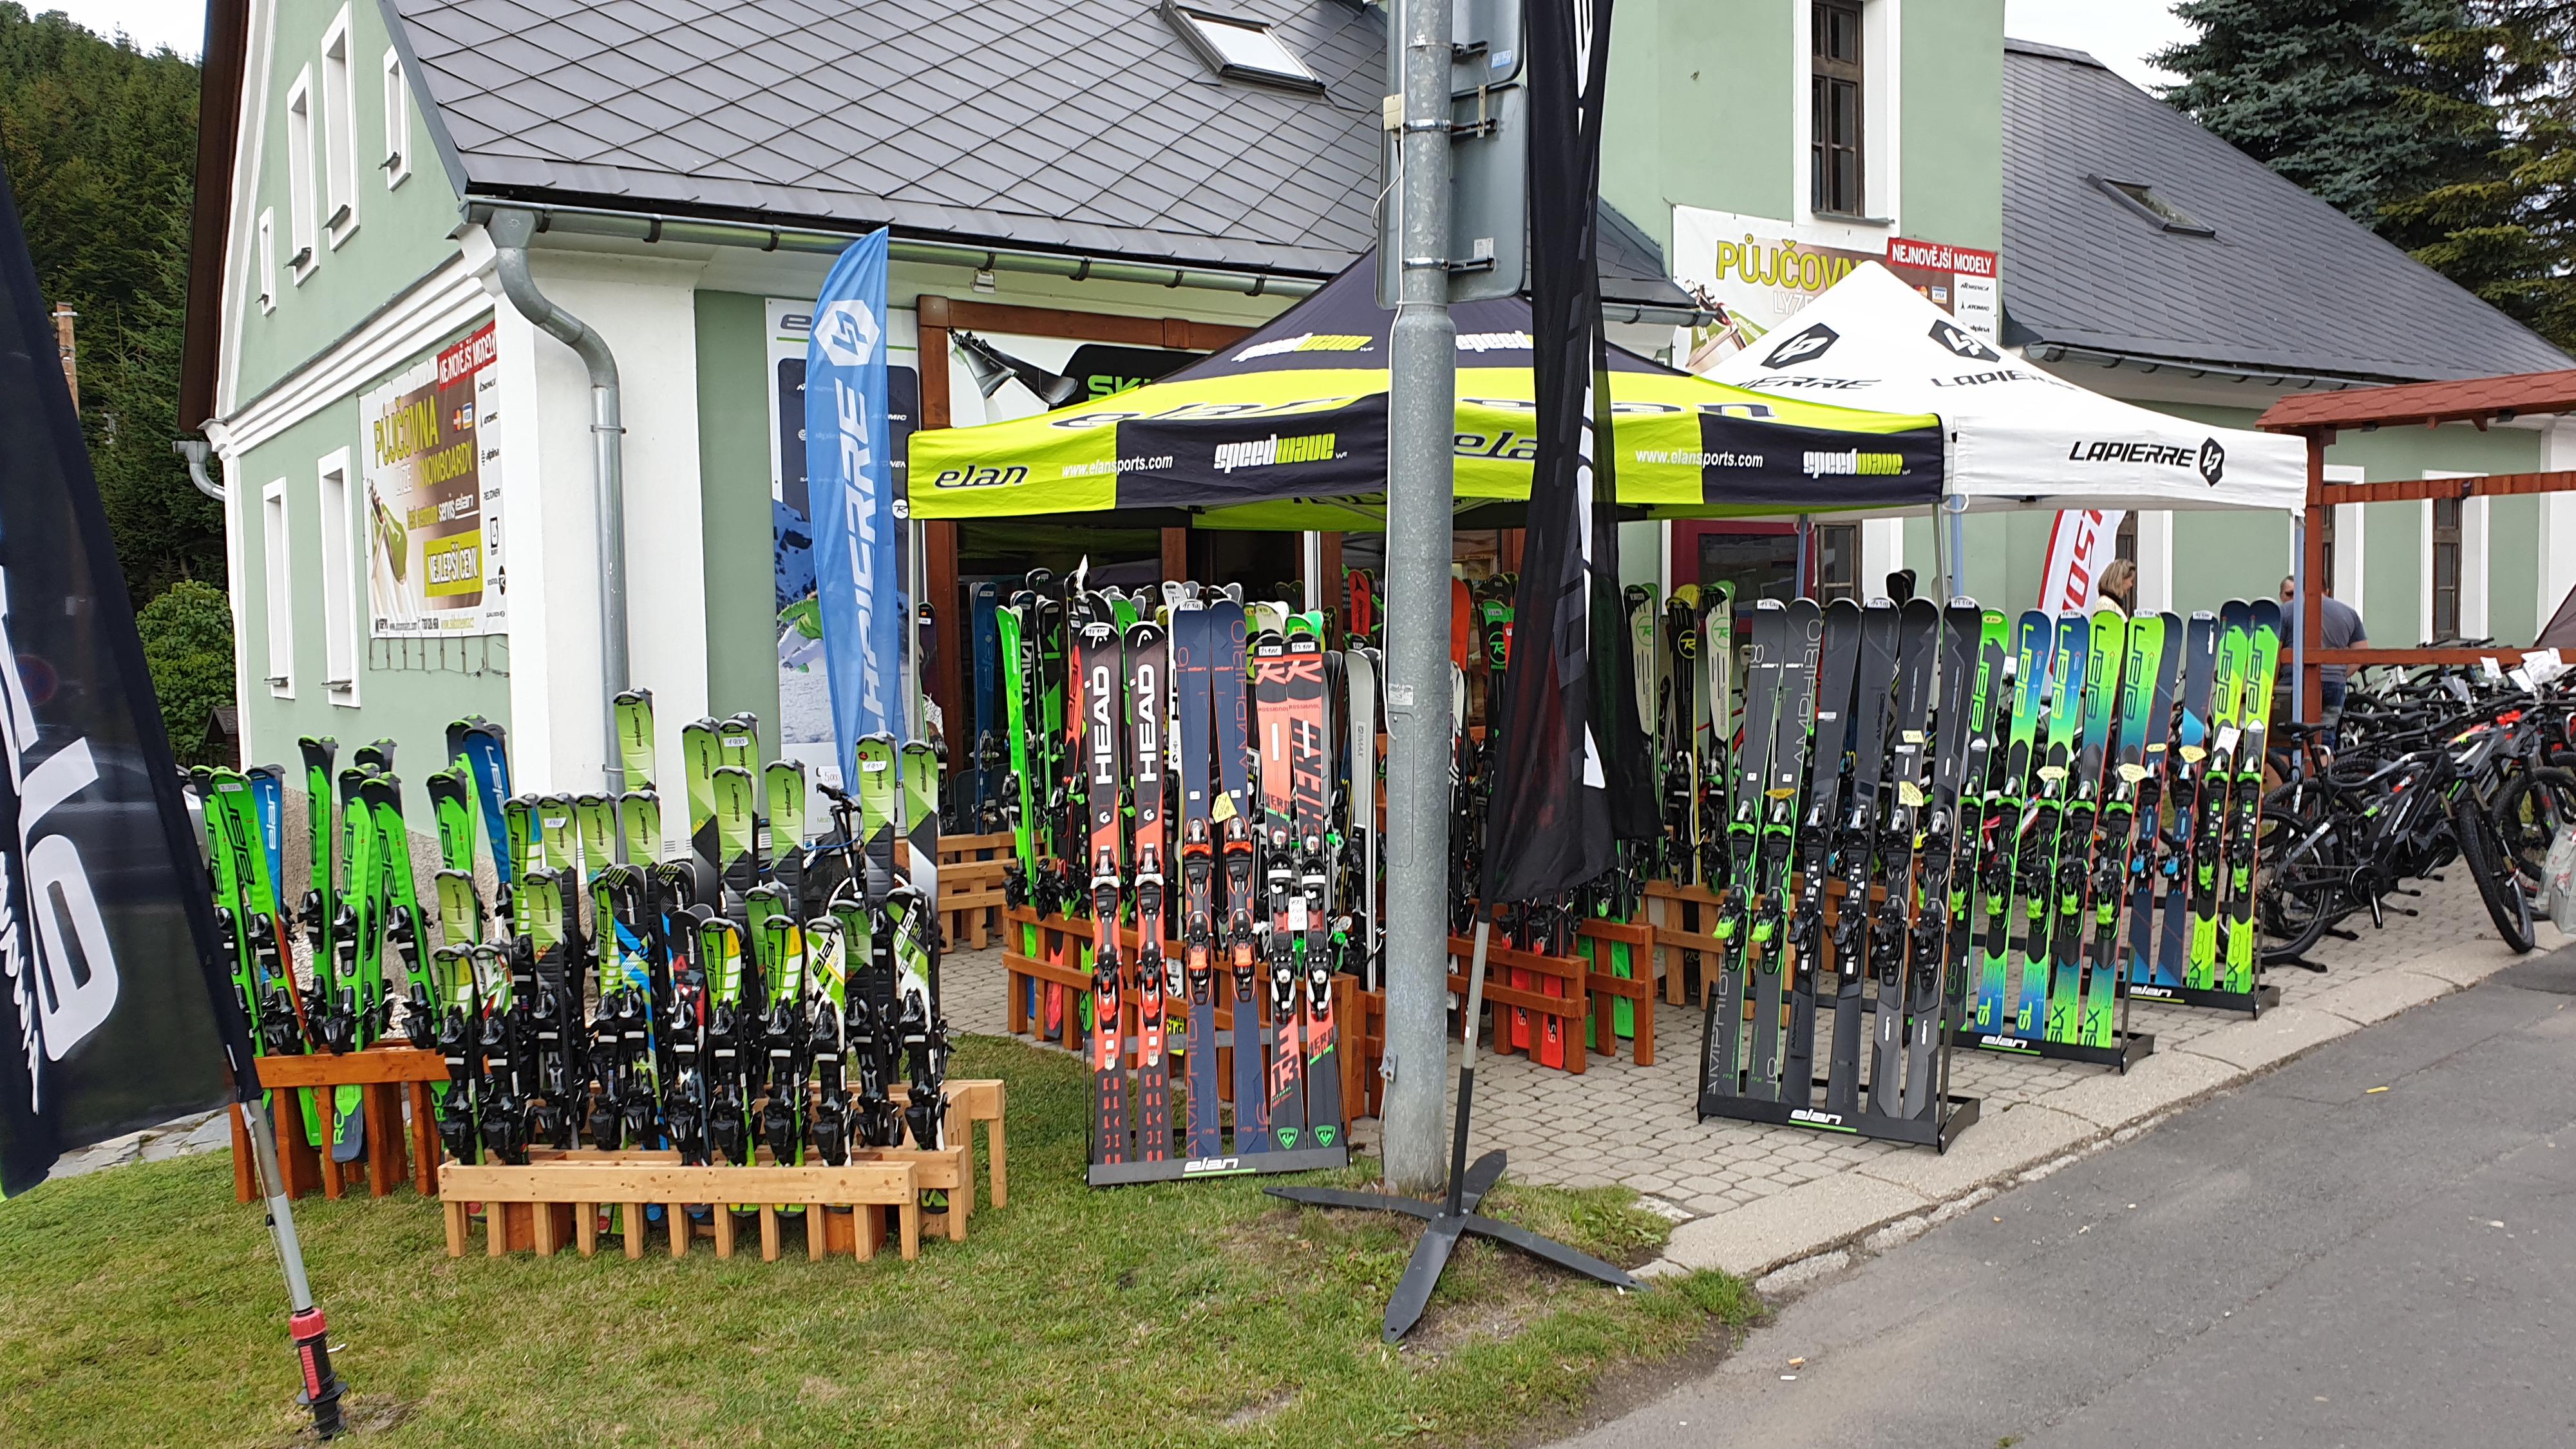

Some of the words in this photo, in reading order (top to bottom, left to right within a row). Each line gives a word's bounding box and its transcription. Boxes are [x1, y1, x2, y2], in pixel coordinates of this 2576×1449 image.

[1716, 234, 1862, 291] PŮJČOV
[1892, 243, 1953, 269] NEJNOVĚJŠÍ
[1954, 252, 1992, 274] MODELY
[439, 337, 473, 384] NEJNOVĚJŠÍ
[473, 328, 497, 366] MODELY
[374, 395, 439, 469] PŮJČOVNA
[1214, 433, 1336, 473] speedwave
[1454, 430, 1537, 459] ela
[1635, 449, 1764, 469] www.elansports.com
[2069, 441, 2197, 467] LAPIERRE
[418, 439, 473, 488] SNOWBOARDY
[934, 464, 1029, 489] elan
[1062, 454, 1173, 478] www.elansports.com
[1803, 448, 1903, 479] speedwave
[439, 493, 455, 522] servis
[428, 542, 459, 584] NEJLEPŠÍ
[459, 545, 479, 579] CENY
[1794, 619, 1823, 764] AMPHIBIO
[1971, 636, 1993, 733] elan
[2013, 623, 2034, 718] elan
[2051, 623, 2072, 720] elan
[2087, 624, 2106, 721] elan
[2125, 624, 2145, 721] elan
[2217, 627, 2235, 714] elan
[2246, 627, 2264, 714] elan
[1092, 665, 1113, 784] HEAD
[1137, 664, 1158, 782] HEAD
[486, 745, 504, 815] elan
[218, 791, 256, 885] elan
[265, 784, 277, 850] elan
[307, 766, 317, 866] elan
[437, 797, 455, 869] lan
[203, 795, 223, 895] elan
[342, 797, 358, 895] elan
[372, 804, 398, 898] elan
[507, 808, 520, 891] elan
[597, 884, 608, 964] elan
[895, 898, 922, 952] elan
[702, 930, 717, 993] elan
[766, 932, 776, 991] elan
[812, 929, 840, 978] elan
[1977, 997, 1992, 1027] SL
[2018, 1001, 2032, 1030] SL
[2130, 985, 2172, 998] elan
[1981, 1034, 2028, 1049] elan
[2050, 1005, 2066, 1043] SLX
[2085, 1008, 2100, 1046] SLX
[333, 1112, 345, 1144] RC
[1790, 1108, 1842, 1124] elan
[1184, 1157, 1239, 1171] elan
